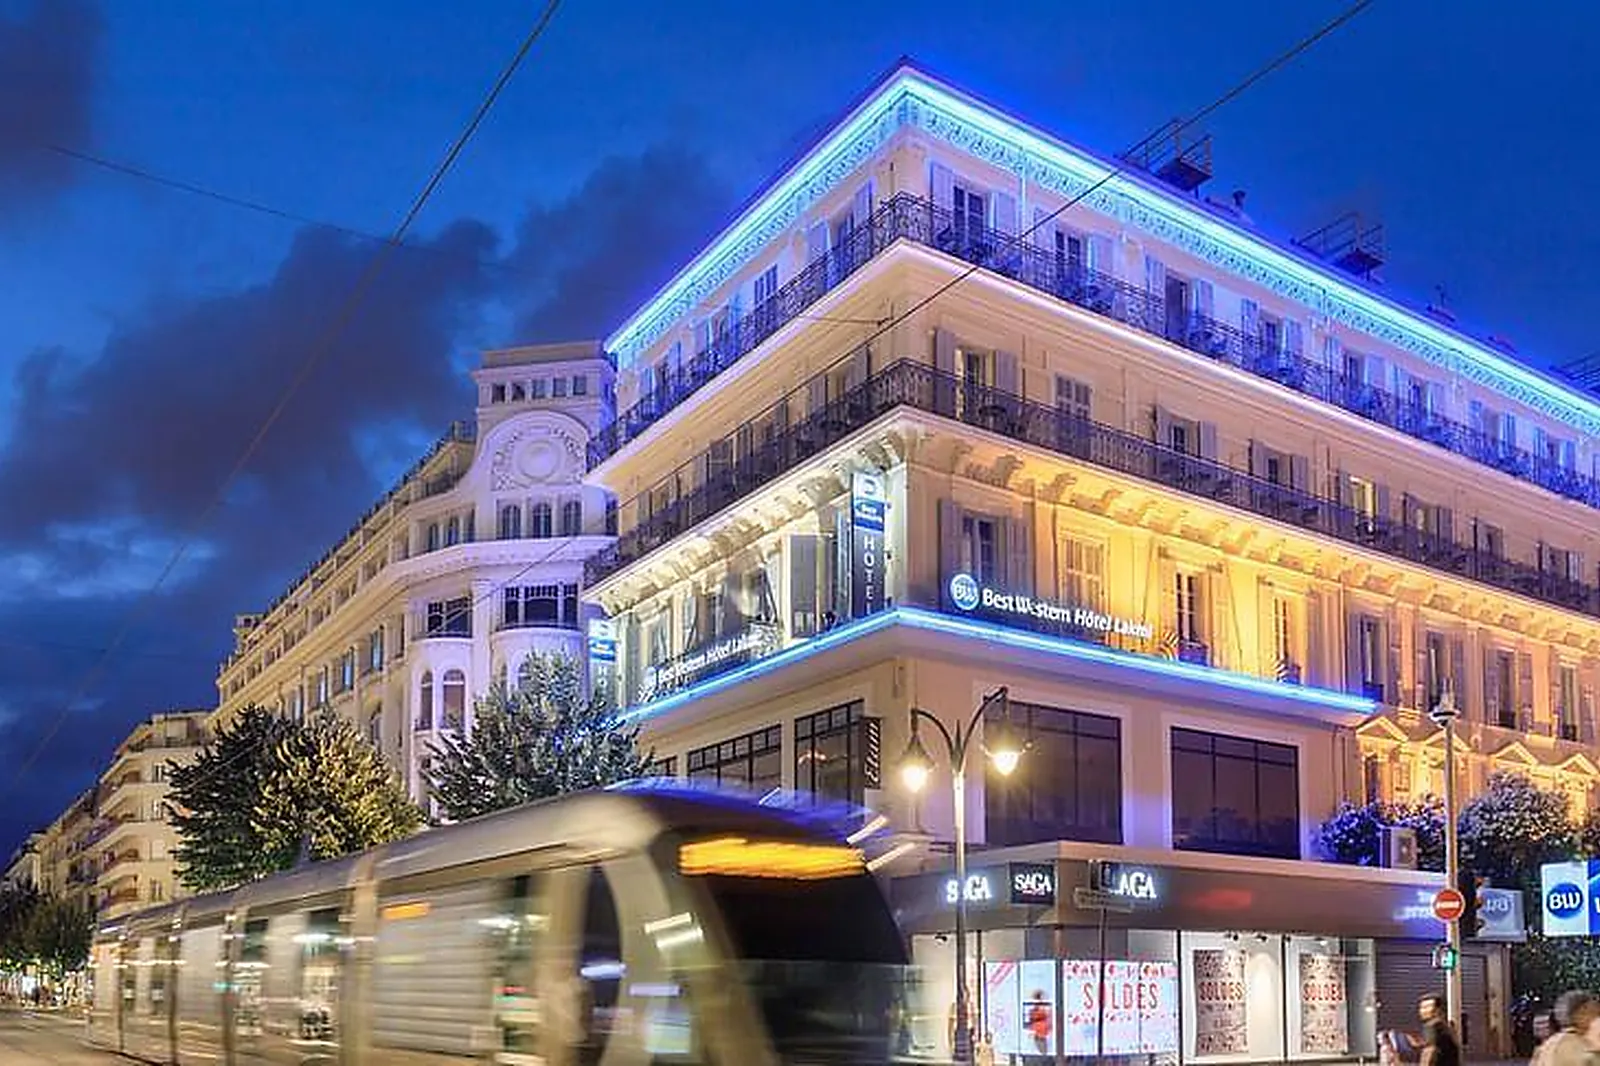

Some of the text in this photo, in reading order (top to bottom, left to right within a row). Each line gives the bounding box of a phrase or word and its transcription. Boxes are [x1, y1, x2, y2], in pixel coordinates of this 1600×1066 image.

[982, 587, 1014, 612] Best
[1013, 872, 1052, 893] SAGA
[1109, 872, 1157, 899] AGA
[1549, 891, 1581, 910] BW
[1199, 980, 1245, 1002] SOLDES
[1302, 982, 1343, 1002] SOLDES
